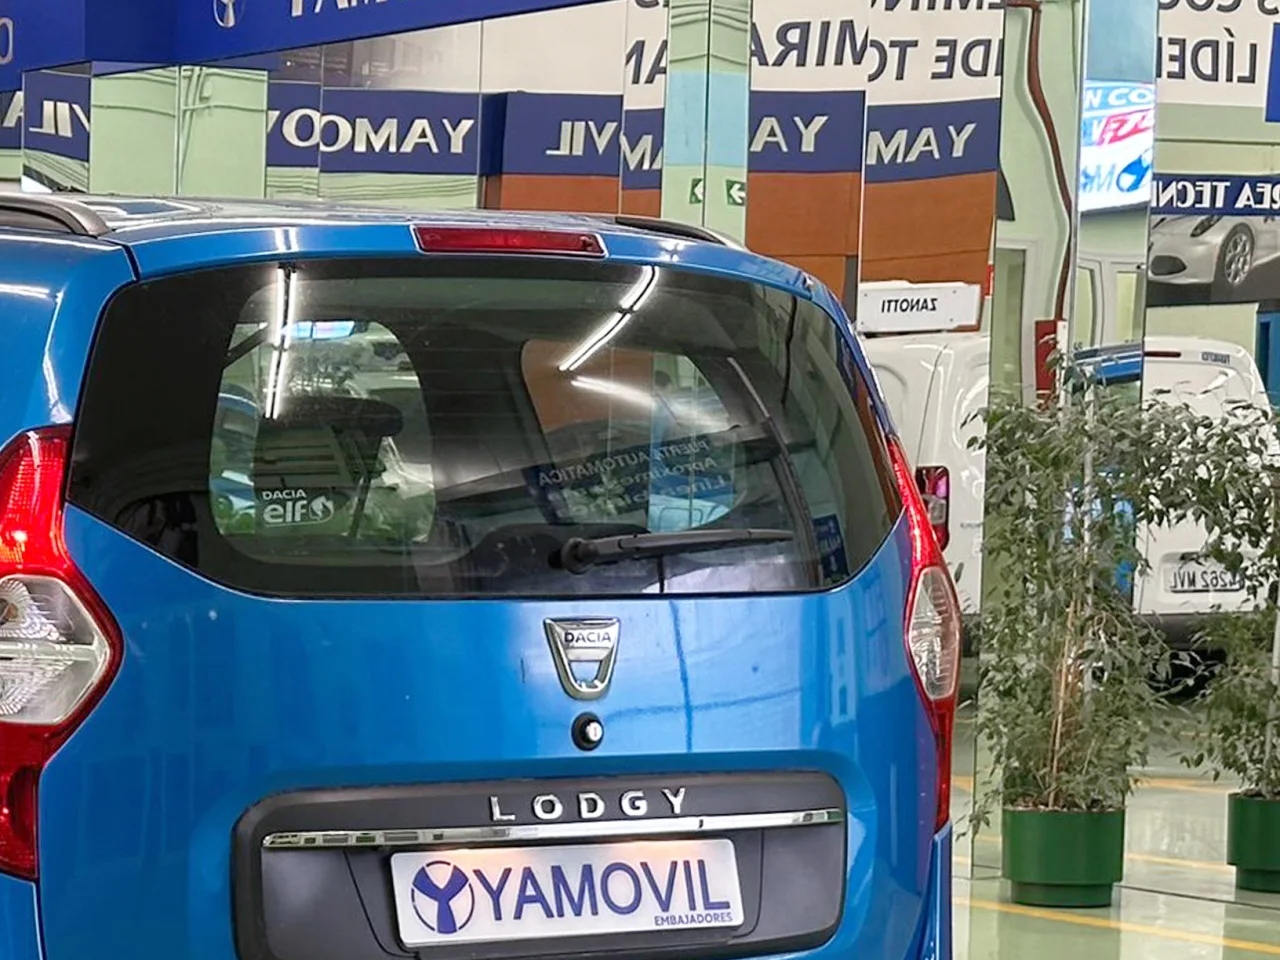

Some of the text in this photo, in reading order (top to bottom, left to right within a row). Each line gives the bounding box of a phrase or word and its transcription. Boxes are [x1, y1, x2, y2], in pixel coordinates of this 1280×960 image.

[262, 489, 307, 500] DACIA
[263, 500, 307, 523] elf
[564, 630, 612, 644] DACIA
[490, 787, 687, 821] LODGY
[472, 858, 731, 921] YAMOVIL
[653, 911, 733, 927] EMBAJADORES
